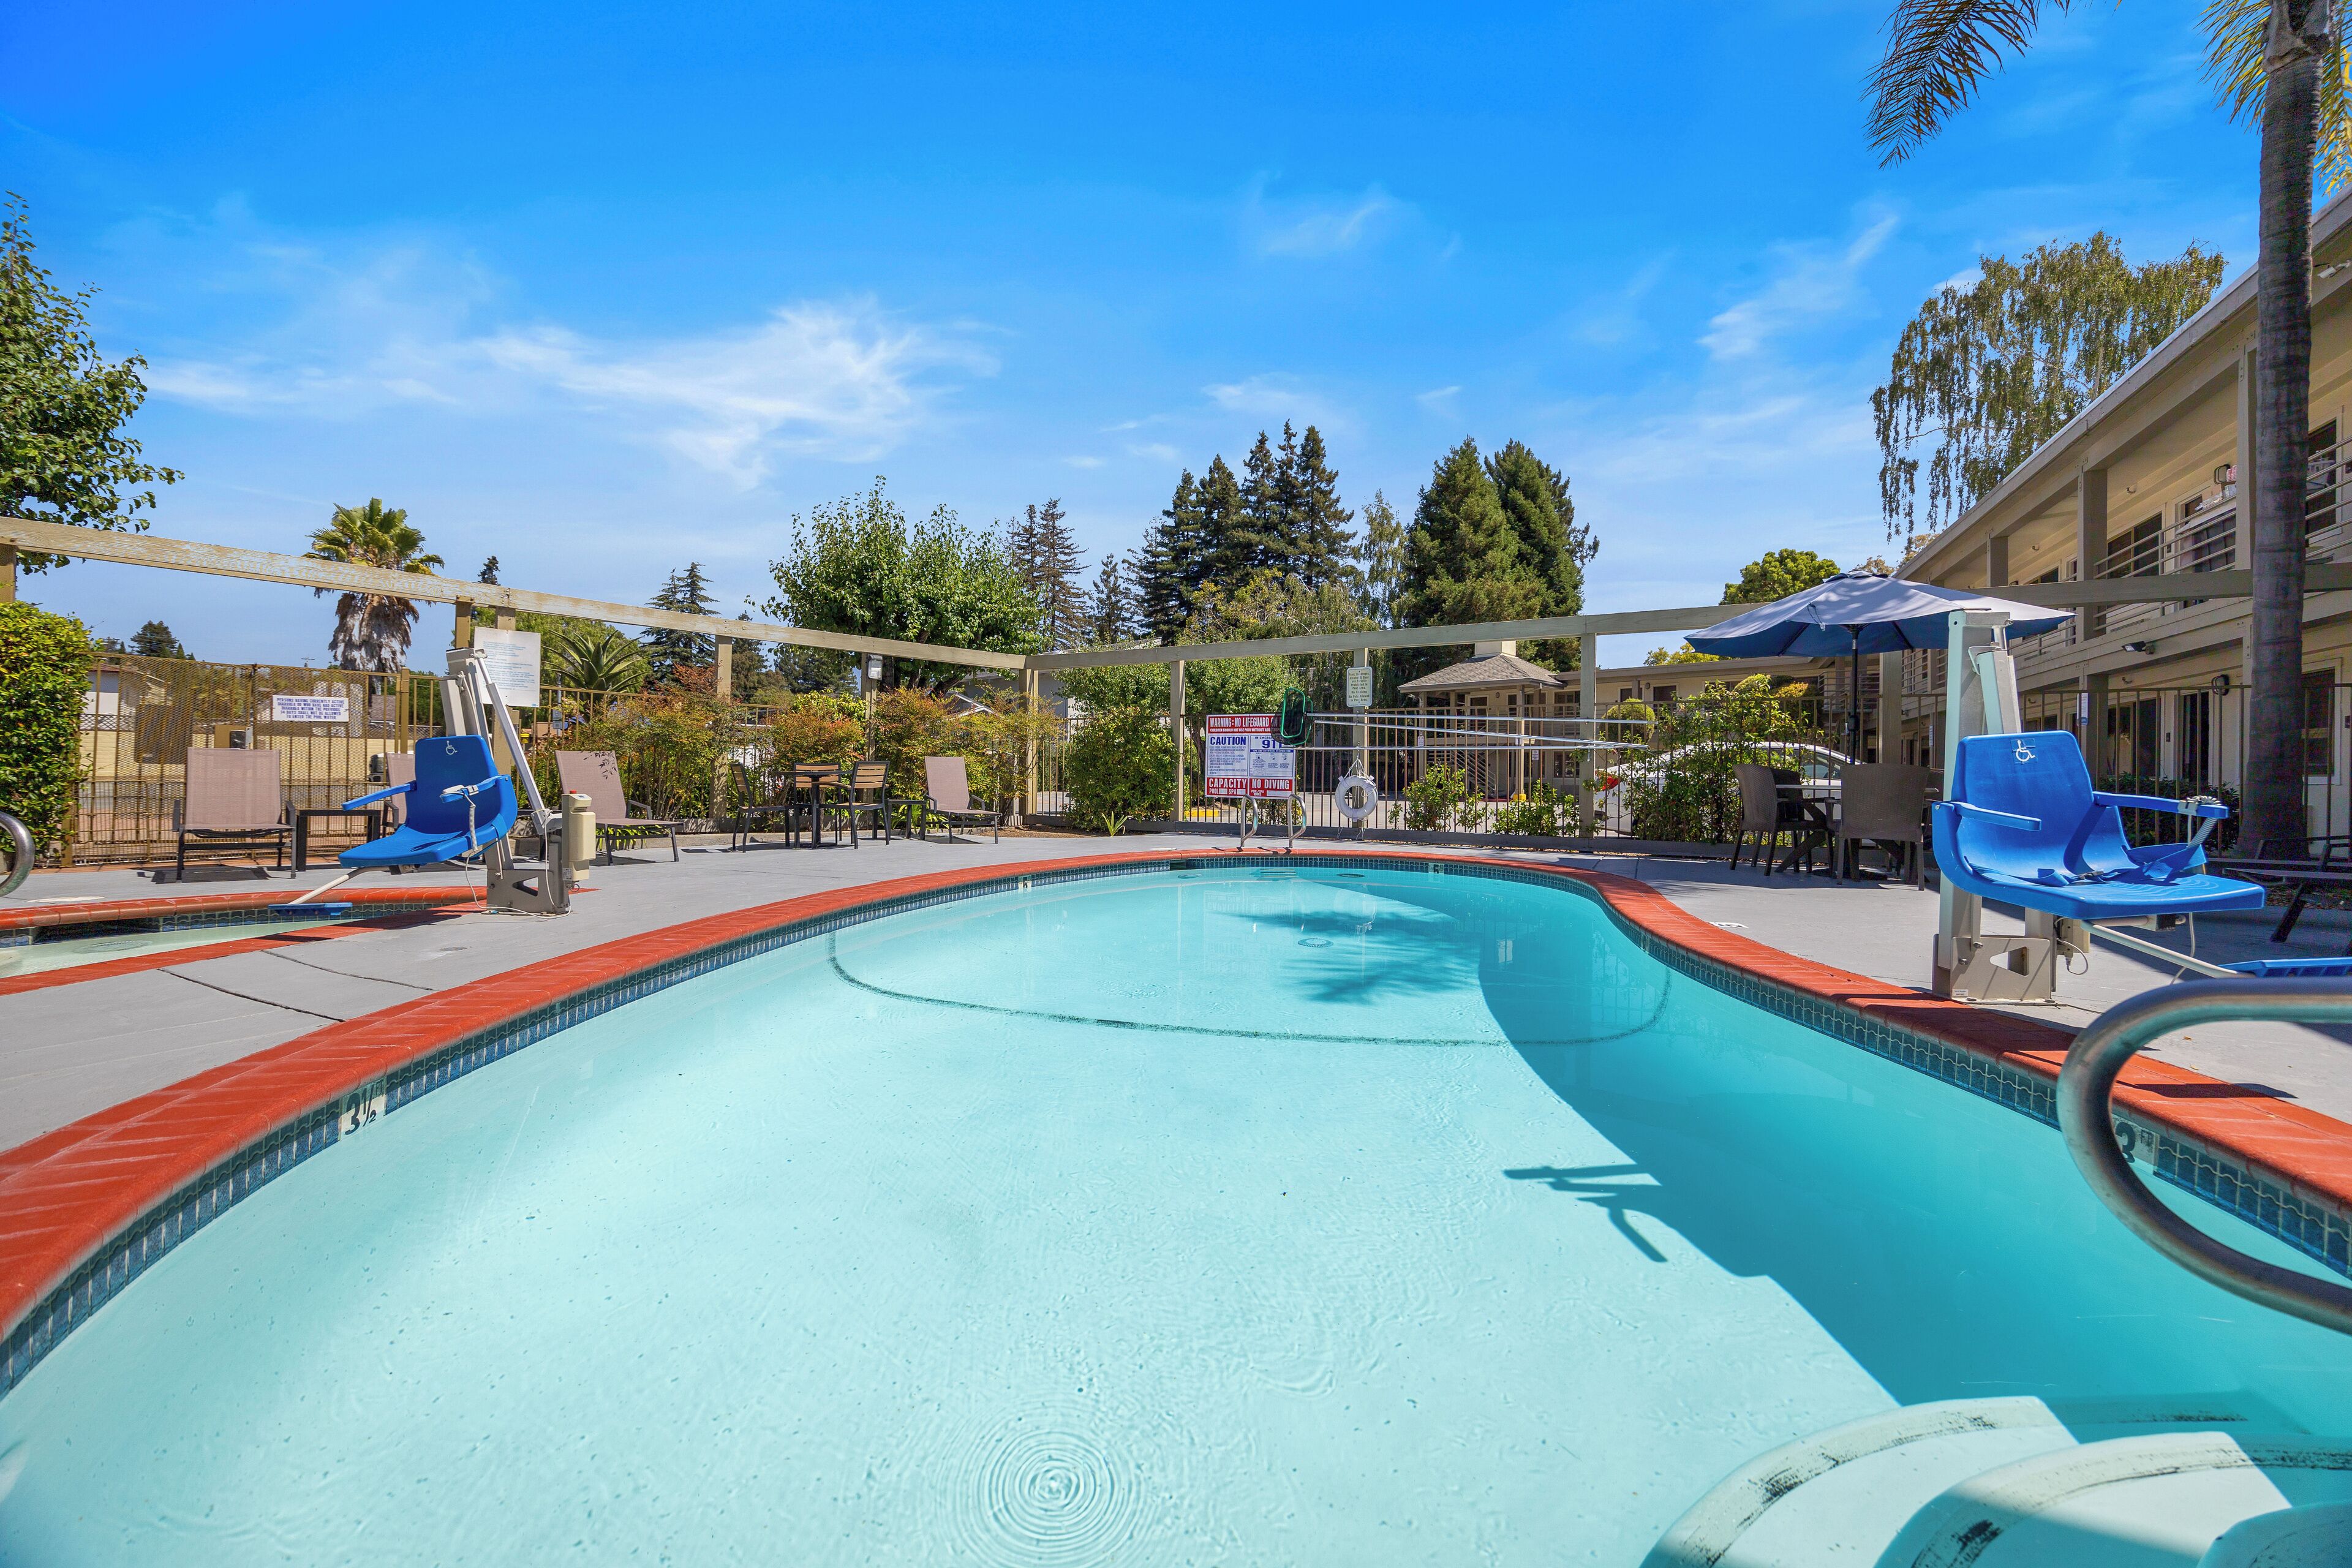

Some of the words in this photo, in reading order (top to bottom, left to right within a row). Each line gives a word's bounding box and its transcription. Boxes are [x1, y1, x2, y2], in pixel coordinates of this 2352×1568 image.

[1210, 718, 1234, 727] WARNING:
[1235, 717, 1241, 727] NO
[1243, 717, 1269, 727] LIFEGUARD
[1262, 740, 1282, 748] 911
[1209, 778, 1247, 788] CAPACITY
[1252, 779, 1261, 788] NO
[1264, 779, 1289, 790] DIVING
[2116, 1122, 2135, 1163] 3
